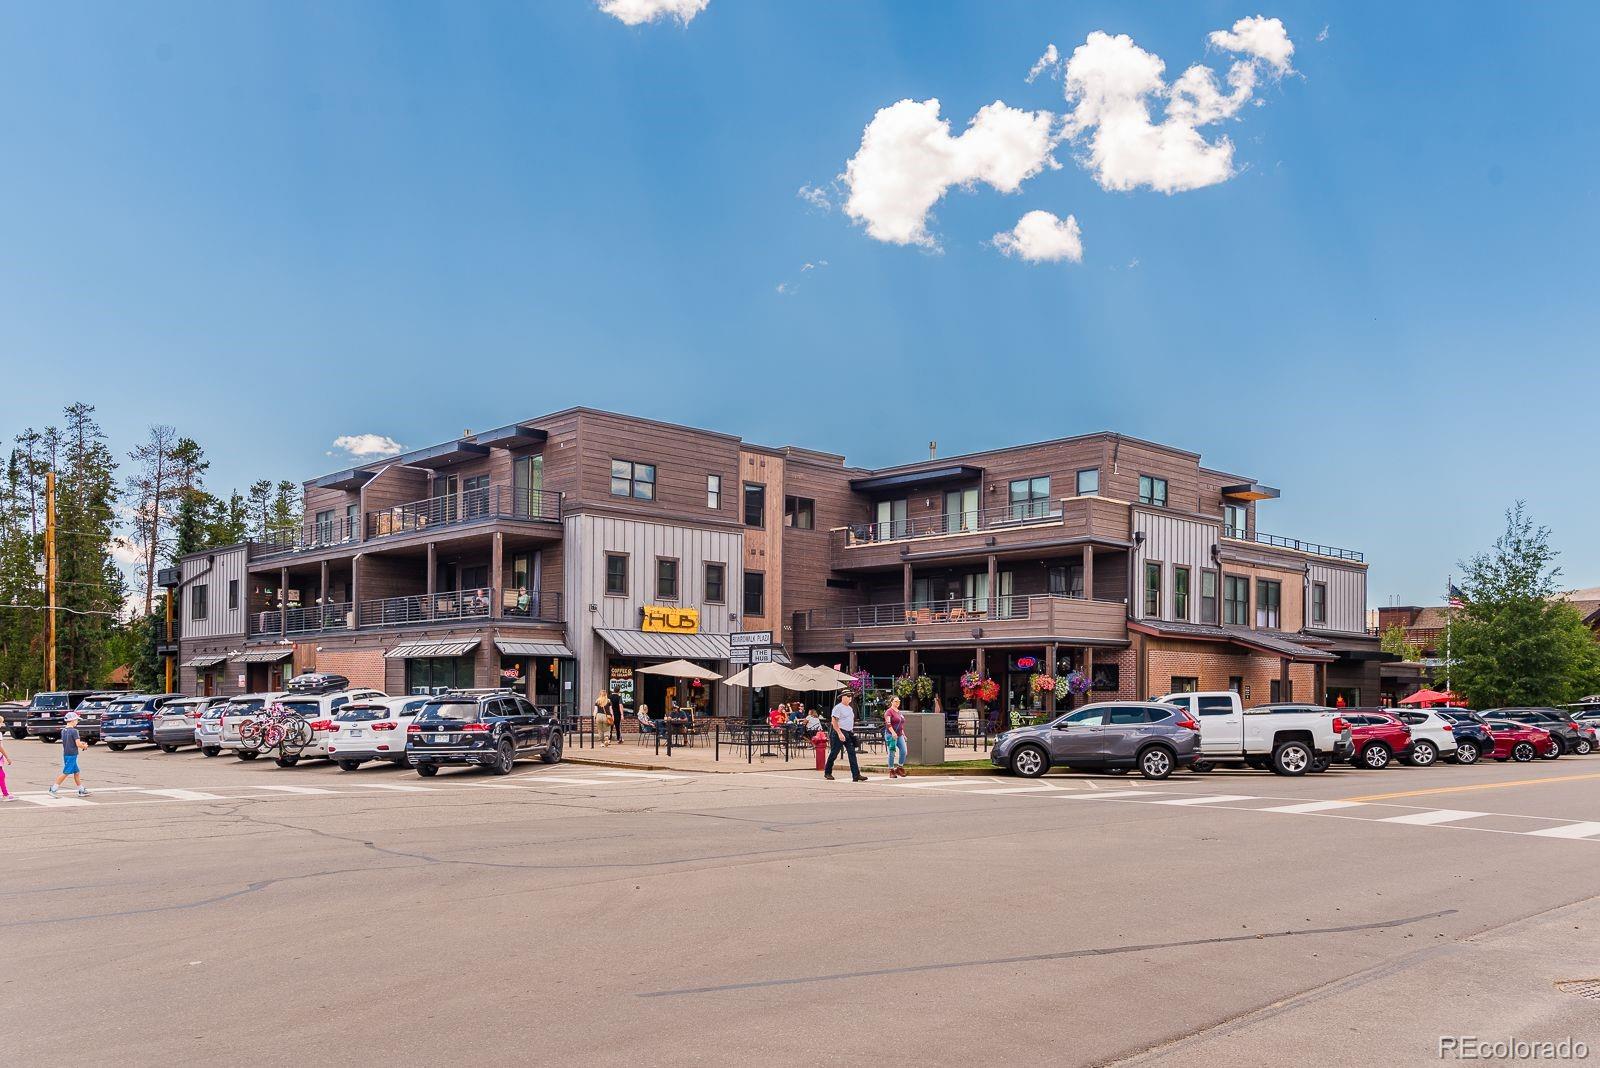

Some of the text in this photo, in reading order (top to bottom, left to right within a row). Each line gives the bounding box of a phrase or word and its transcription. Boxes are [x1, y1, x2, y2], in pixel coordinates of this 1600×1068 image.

[649, 613, 695, 628] HUB
[757, 634, 770, 642] PLAZA
[504, 670, 519, 678] OPEN
